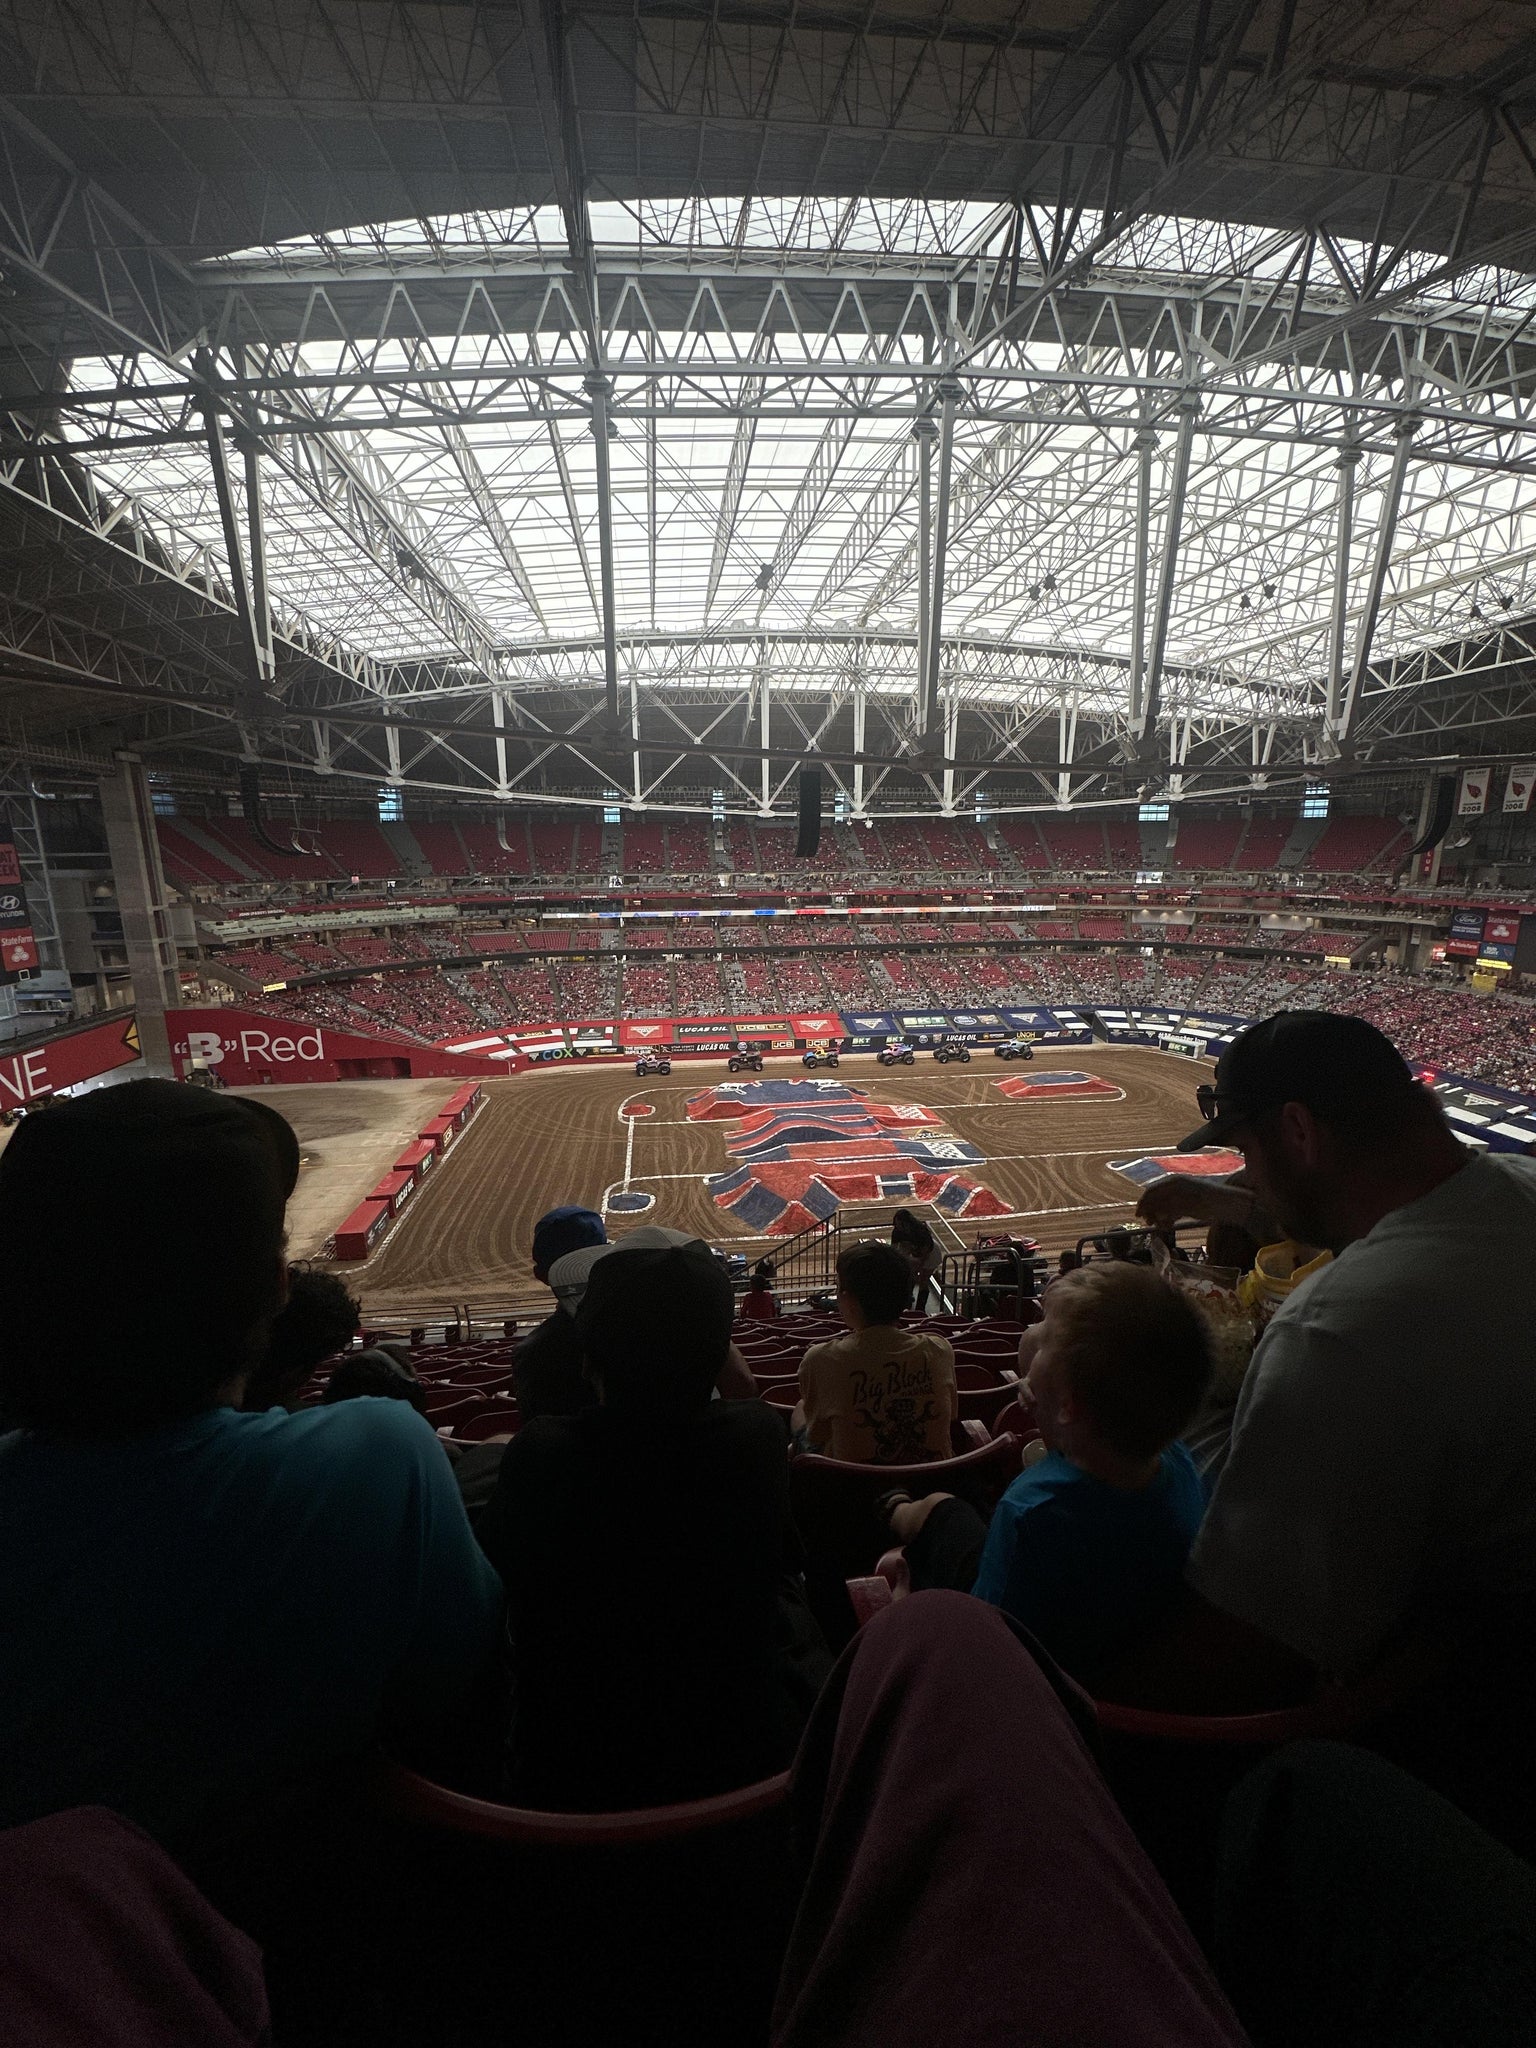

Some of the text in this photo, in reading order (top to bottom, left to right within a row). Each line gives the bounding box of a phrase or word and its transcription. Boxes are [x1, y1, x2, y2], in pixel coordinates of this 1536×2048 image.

[1461, 805, 1481, 813] 2008
[1504, 802, 1523, 810] 2008
[1459, 915, 1477, 923] Ford
[679, 1025, 710, 1033] LUCAS
[240, 1028, 325, 1063] Red
[542, 1048, 573, 1061] COX
[849, 1356, 932, 1413] Big Block
